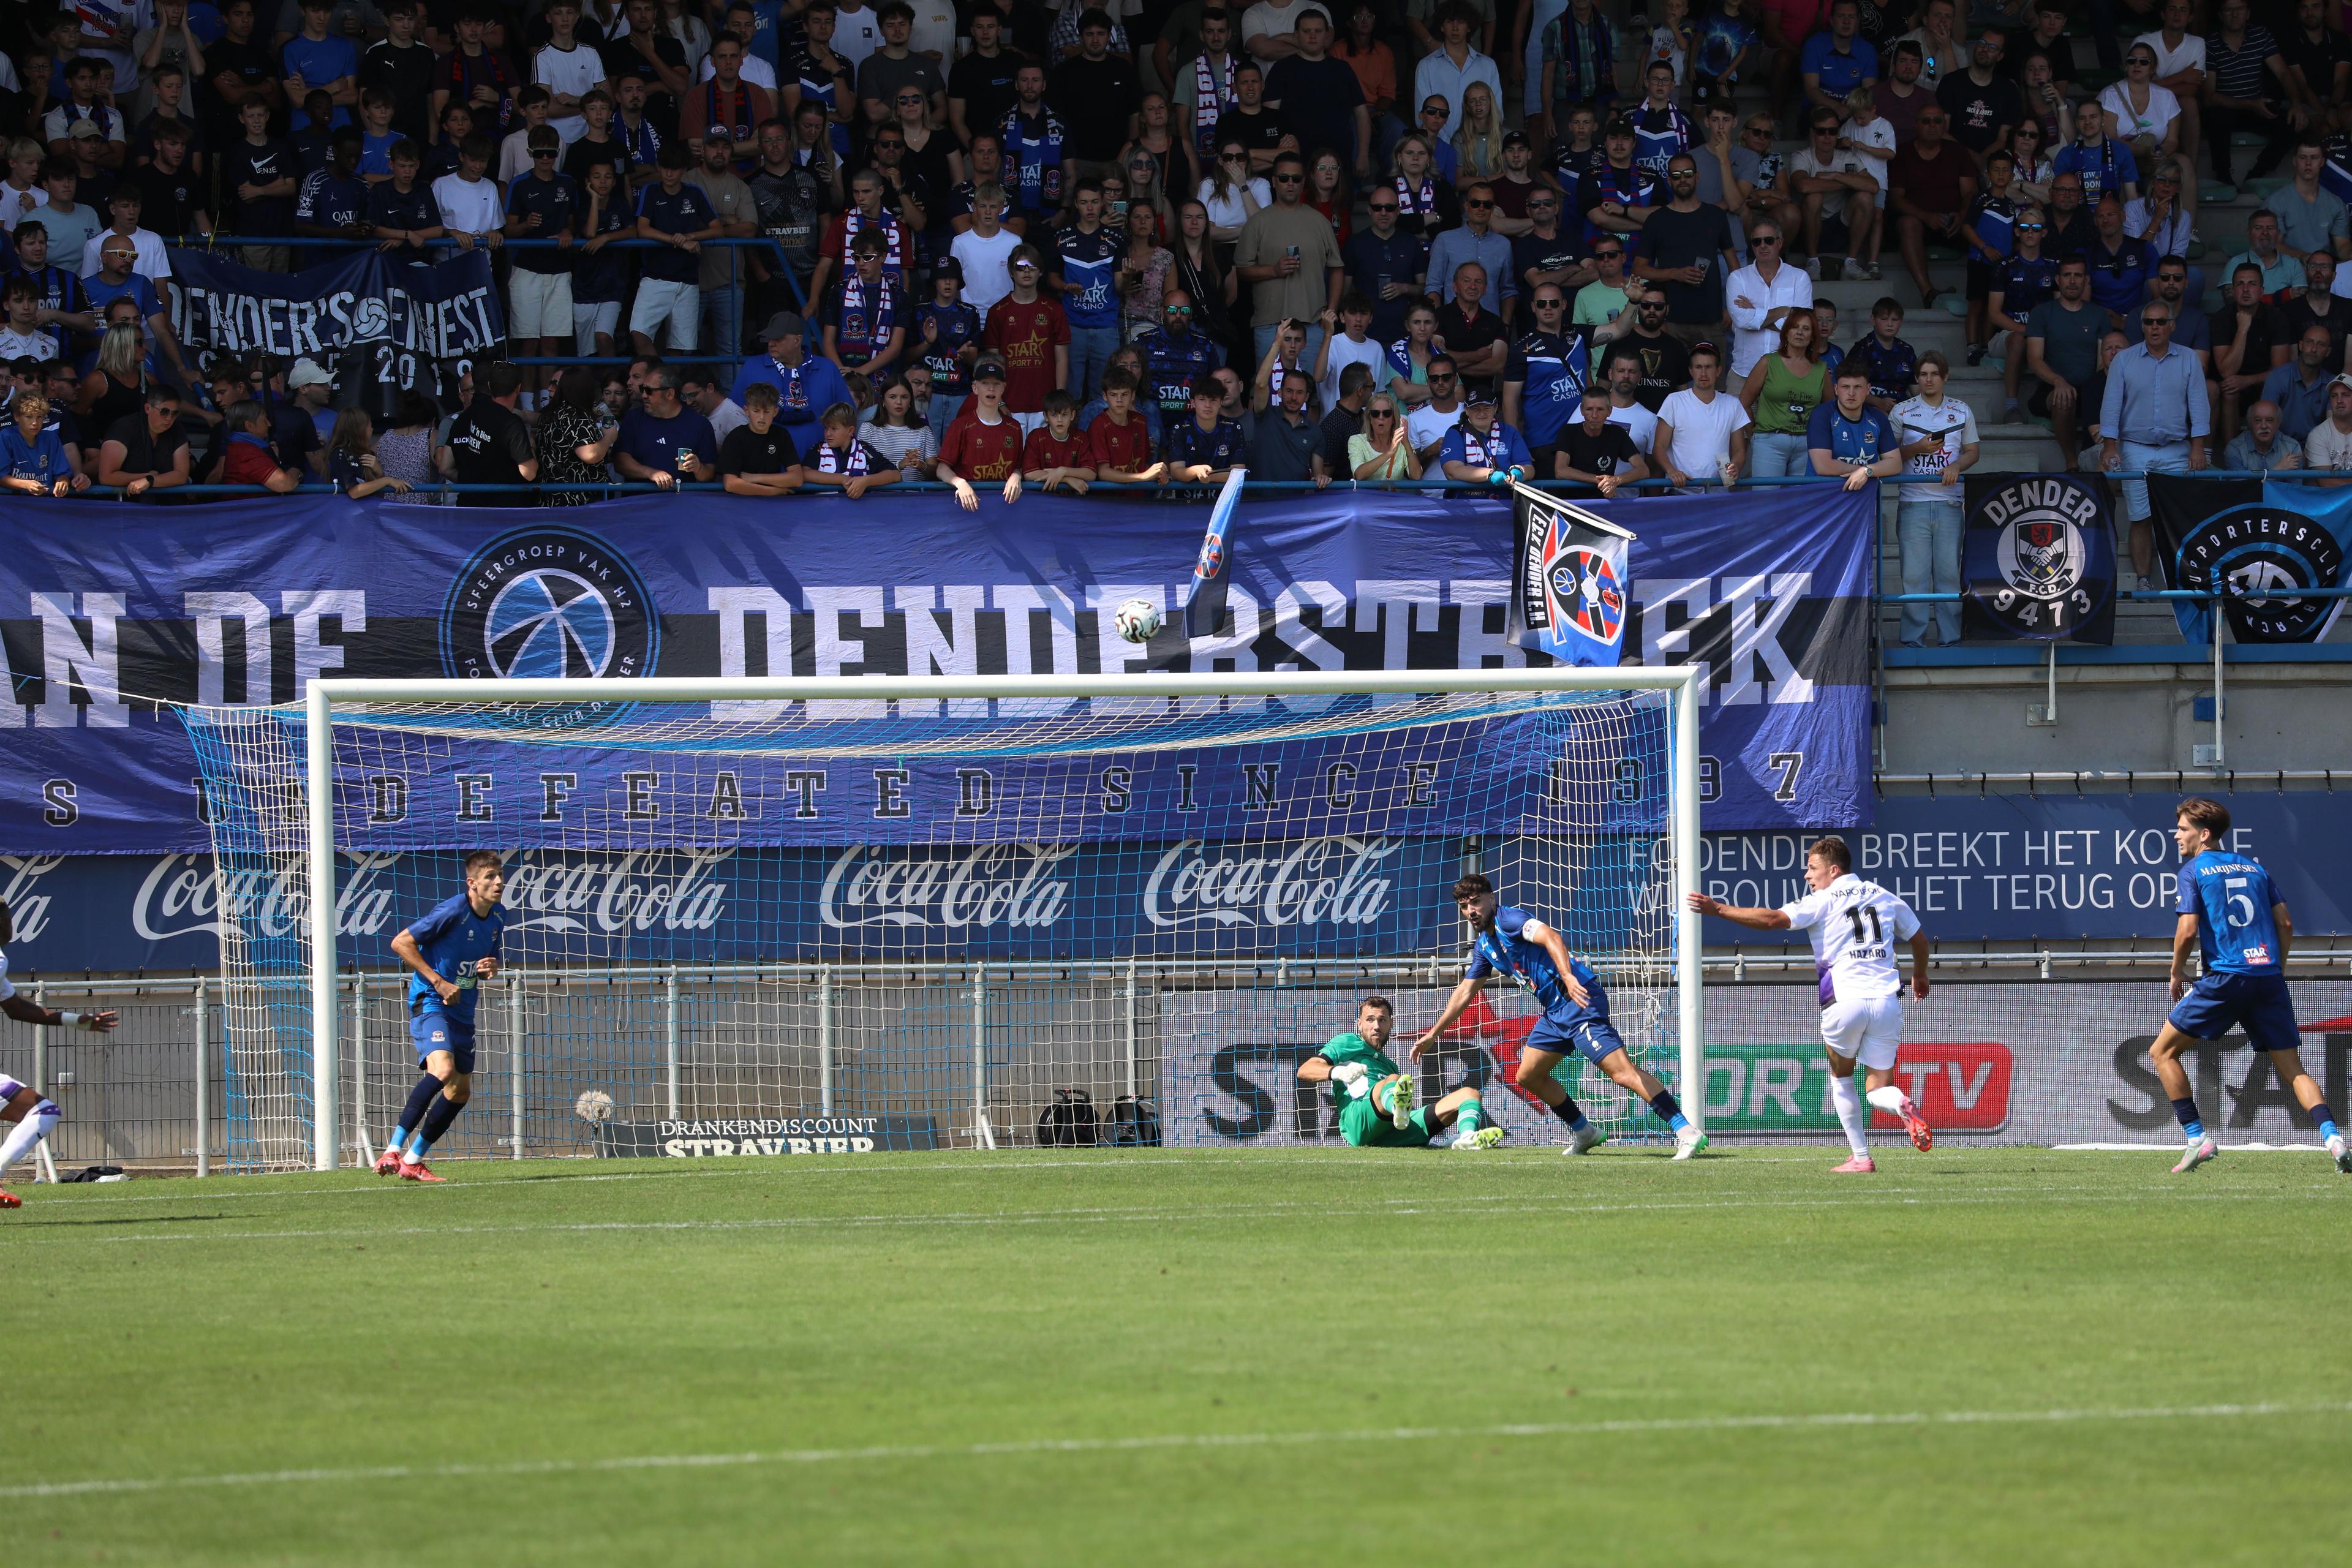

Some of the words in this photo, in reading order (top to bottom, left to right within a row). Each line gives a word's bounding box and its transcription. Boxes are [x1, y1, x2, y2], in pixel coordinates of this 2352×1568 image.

[924, 356, 956, 371] STAR
[1006, 343, 1042, 358] STAR
[1159, 385, 1191, 399] STAR
[973, 466, 1009, 480] STAR
[1913, 454, 1946, 467] STAR
[1983, 480, 2097, 527] DENDER
[1526, 545, 1542, 598] DENDER
[2188, 519, 2335, 588] UPPORTERSCLU
[466, 544, 566, 611] SFEERGROEP
[578, 551, 611, 581] VAK
[1994, 588, 2092, 628] 9473
[708, 572, 1814, 723] DENDERSTREK
[590, 656, 636, 713] DER
[1099, 760, 1439, 816] SINCE
[1544, 752, 1804, 809] 1997
[1862, 831, 2009, 869] BREEKT
[2027, 829, 2101, 867] HET
[820, 843, 1083, 929] Coca-Cola
[1143, 837, 1404, 927] Coca-Cola
[2199, 863, 2259, 876] MARIJNISSEN
[132, 851, 404, 941] Coca-Cla
[1709, 877, 1878, 910] BOUW
[1896, 875, 1971, 911] HET
[1983, 873, 2114, 910] TERUG
[1831, 888, 1881, 899] NAPOLEON
[2224, 876, 2255, 928] 5
[1844, 904, 1884, 945] 11
[459, 961, 478, 976] STA
[1849, 949, 1887, 960] HAZARD
[2243, 947, 2267, 958] STAR
[1579, 1022, 1593, 1042] 7
[1202, 1042, 1504, 1138] STR
[1899, 1061, 1995, 1111] TV
[659, 1118, 877, 1136] DRANKENDISCOUNT
